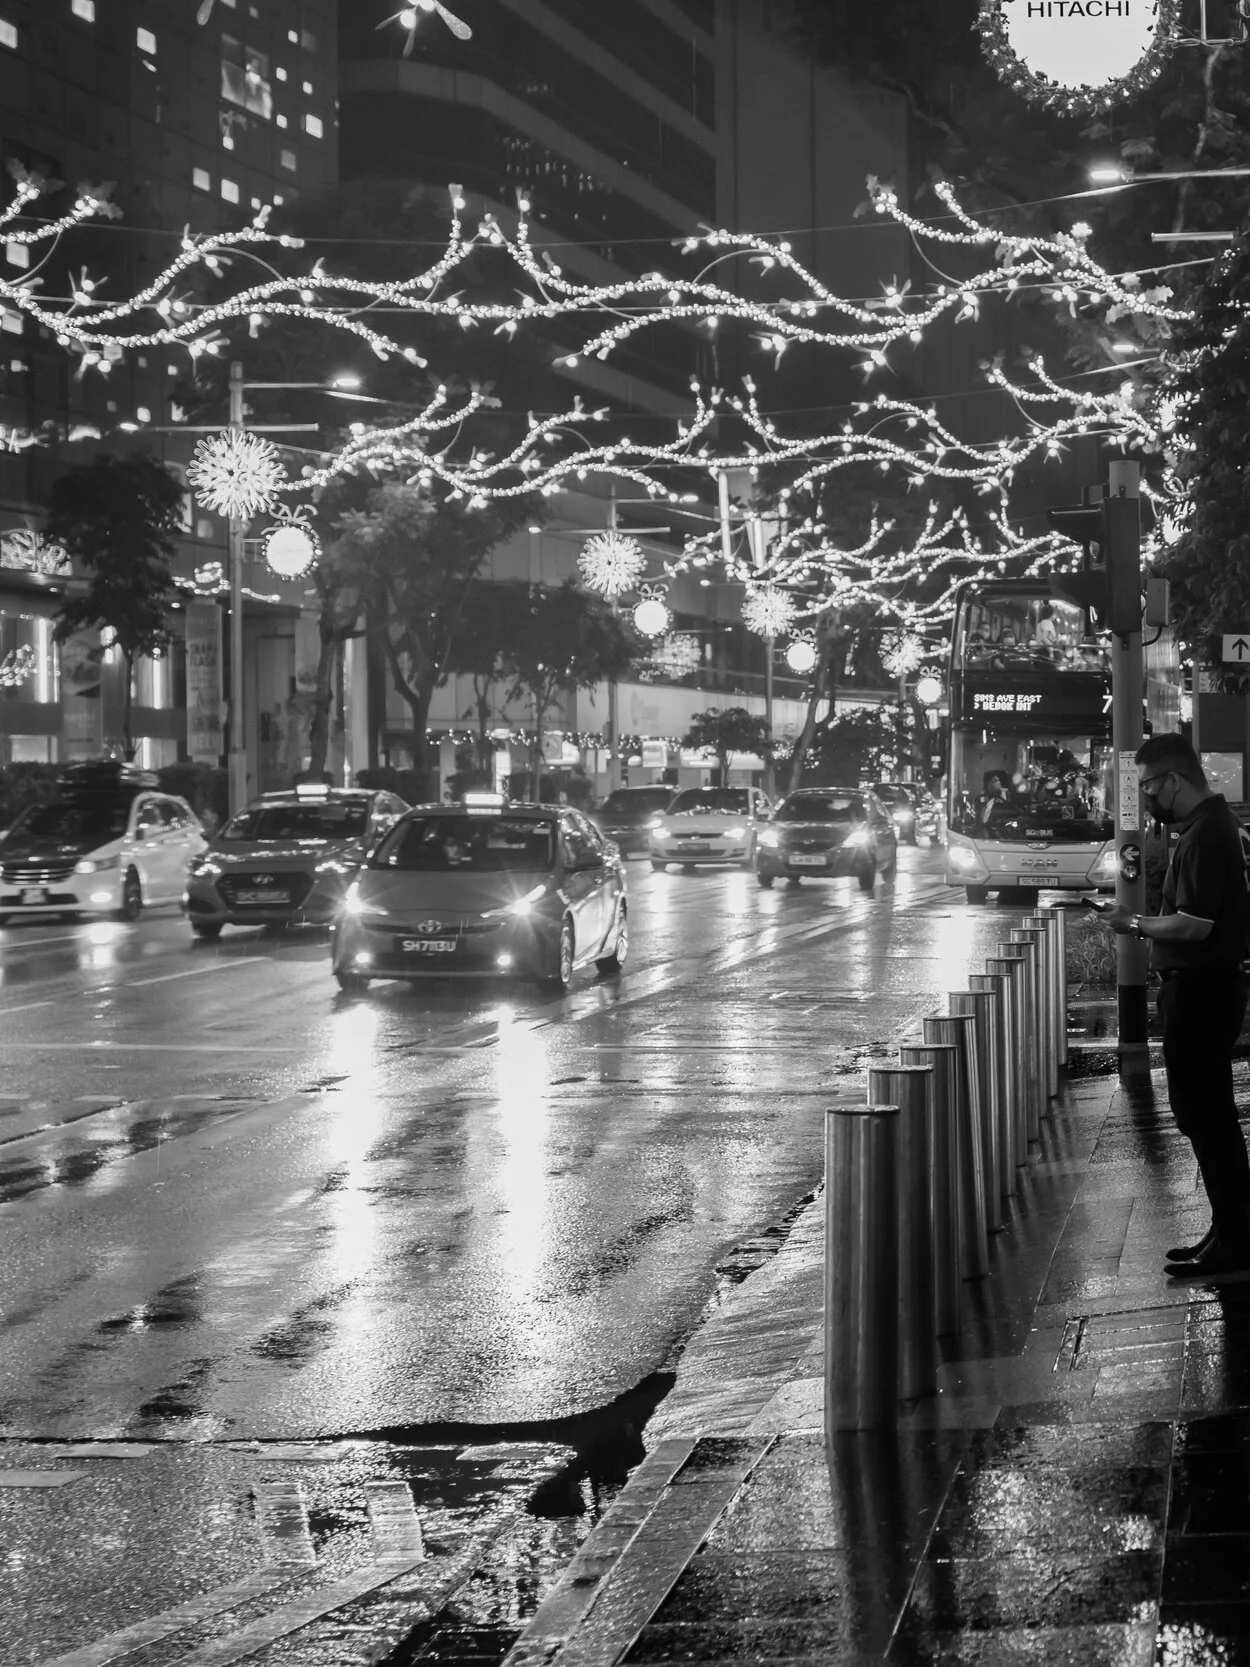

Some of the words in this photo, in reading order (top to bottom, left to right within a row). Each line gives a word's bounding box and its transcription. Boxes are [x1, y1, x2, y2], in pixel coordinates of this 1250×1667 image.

[1027, 1, 1130, 18] HITACHI
[974, 693, 995, 702] SIMS
[996, 694, 1015, 703] AVE
[1017, 694, 1042, 703] EAST
[982, 702, 1014, 711] BEDOK
[1016, 702, 1032, 711] INT
